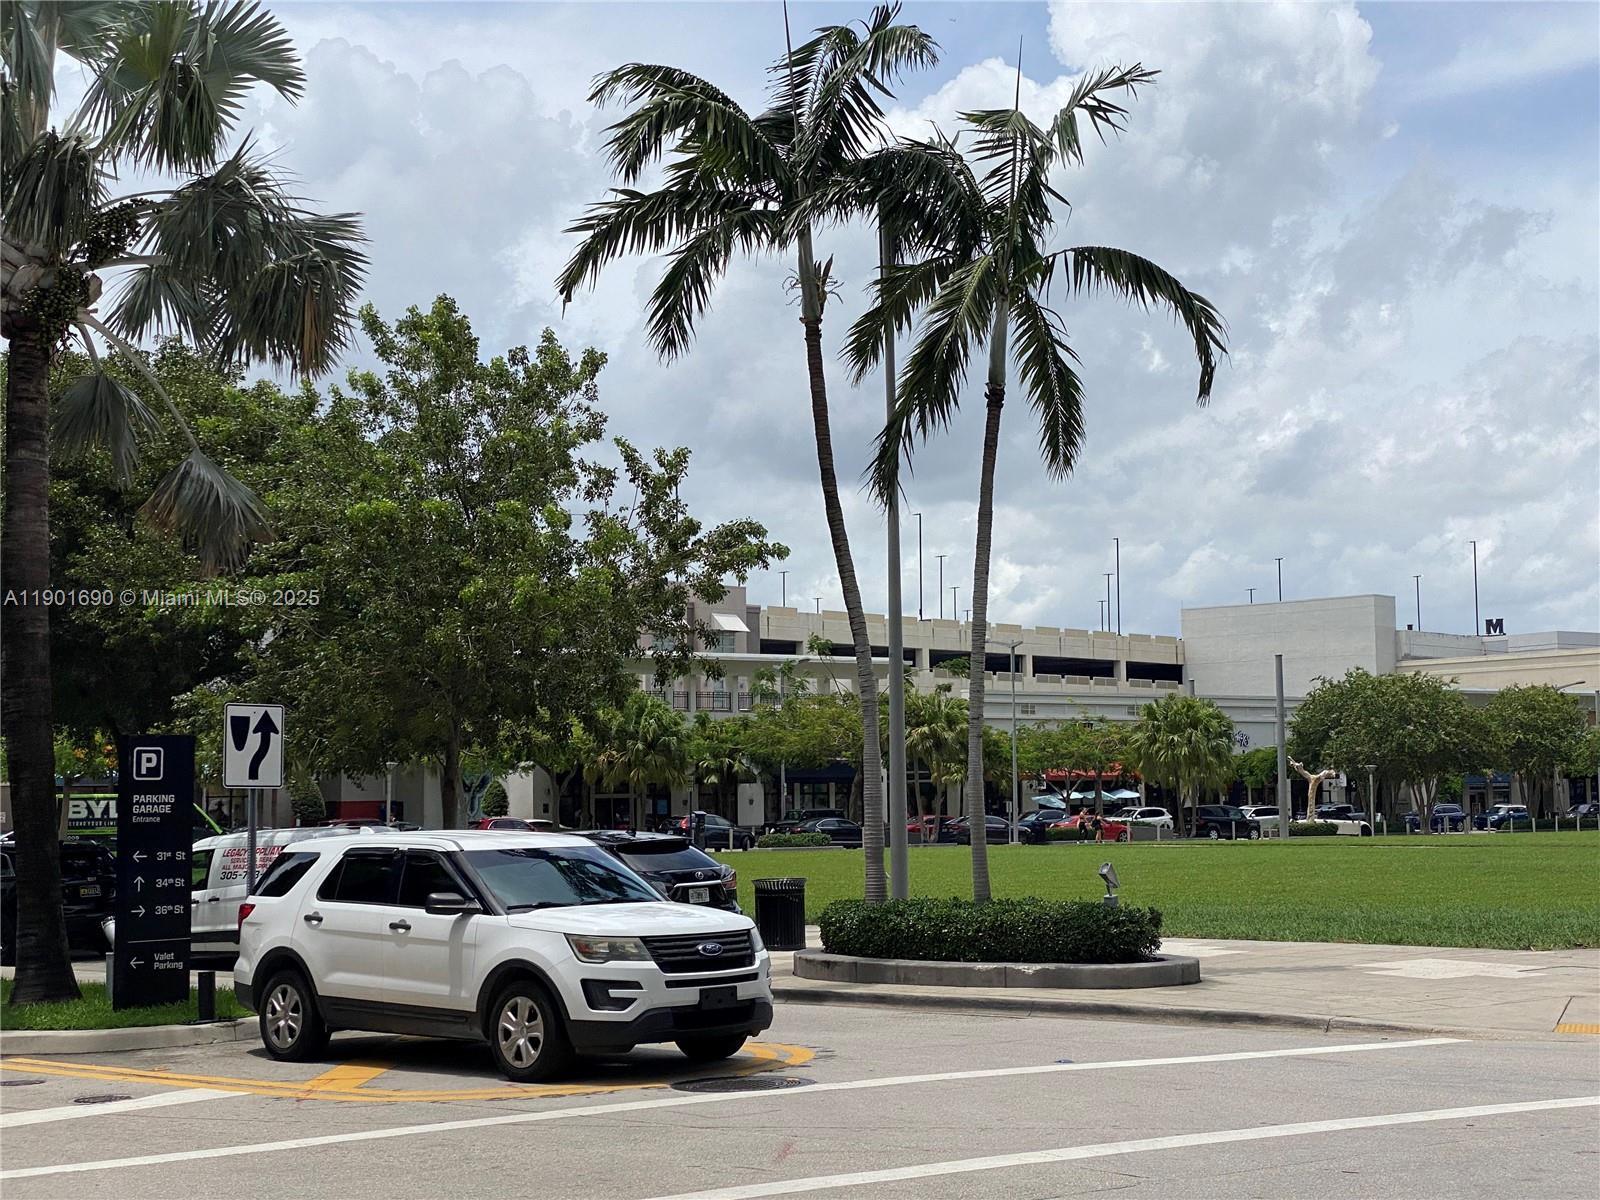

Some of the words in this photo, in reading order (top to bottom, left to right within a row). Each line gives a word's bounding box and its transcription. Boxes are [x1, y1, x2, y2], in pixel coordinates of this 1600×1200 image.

[141, 752, 158, 775] P
[133, 794, 175, 803] PARKING
[132, 804, 172, 814] GARAGE
[132, 815, 161, 823] Entrance
[156, 851, 172, 861] 31st
[175, 851, 186, 861] St
[222, 847, 248, 858] LEGACY
[255, 845, 282, 856] PPLIAN
[174, 878, 185, 887] St
[174, 904, 185, 914] St
[153, 952, 175, 961] Valet
[153, 960, 184, 970] Parking
